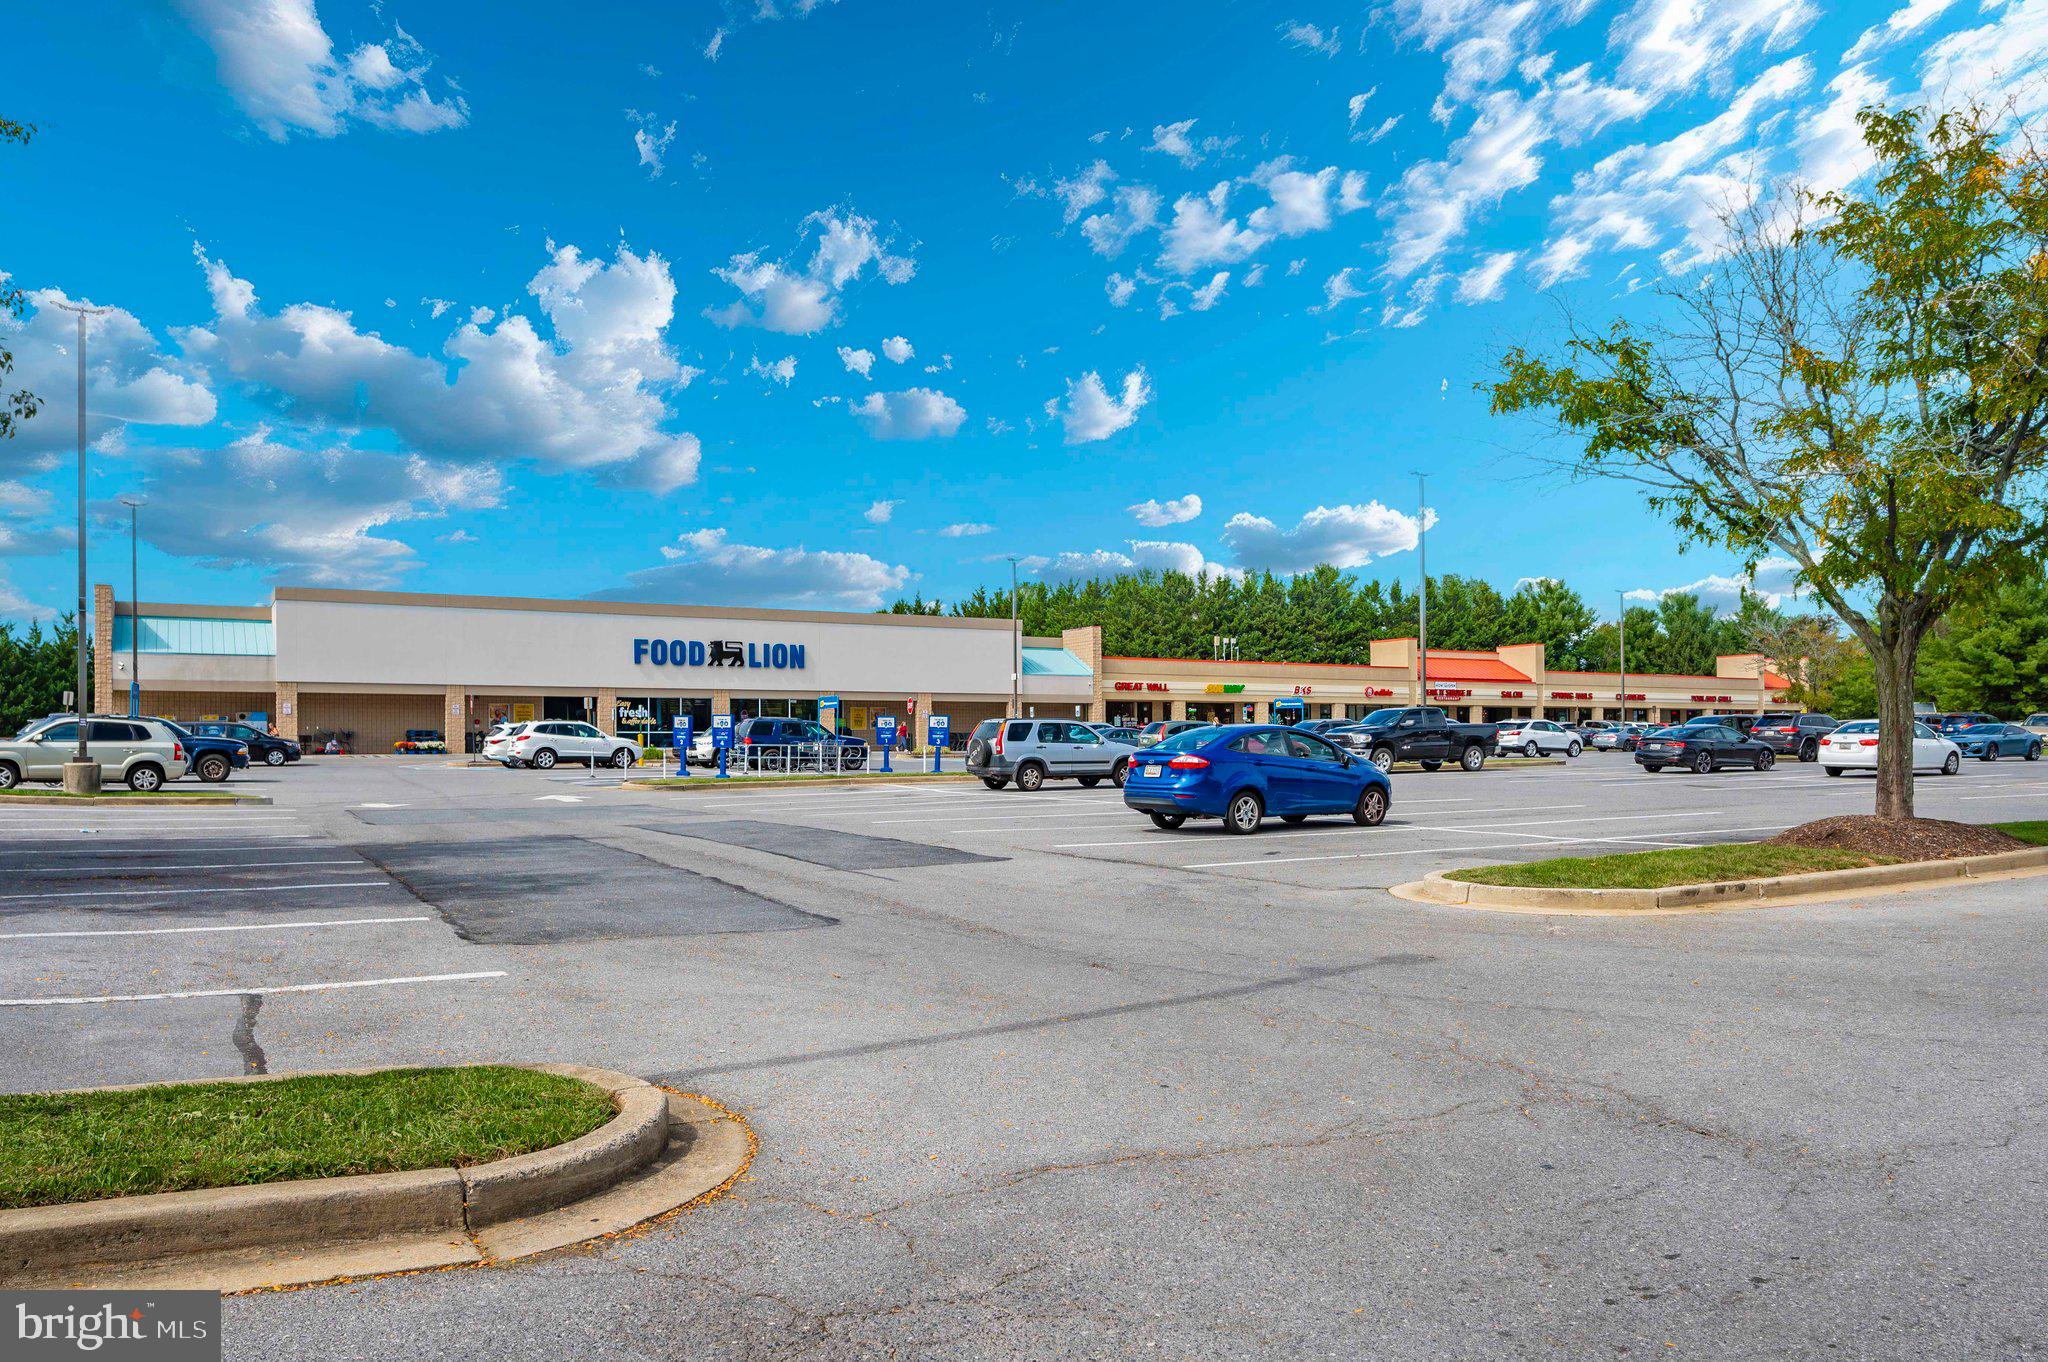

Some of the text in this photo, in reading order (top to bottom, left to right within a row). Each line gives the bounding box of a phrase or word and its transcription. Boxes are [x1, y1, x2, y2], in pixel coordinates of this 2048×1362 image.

[633, 638, 806, 669] FOOD LION
[1114, 682, 1170, 693] GREAT WALL
[1204, 684, 1246, 694] SUBWAY
[1501, 691, 1523, 699] SALON
[619, 704, 648, 718] fresh
